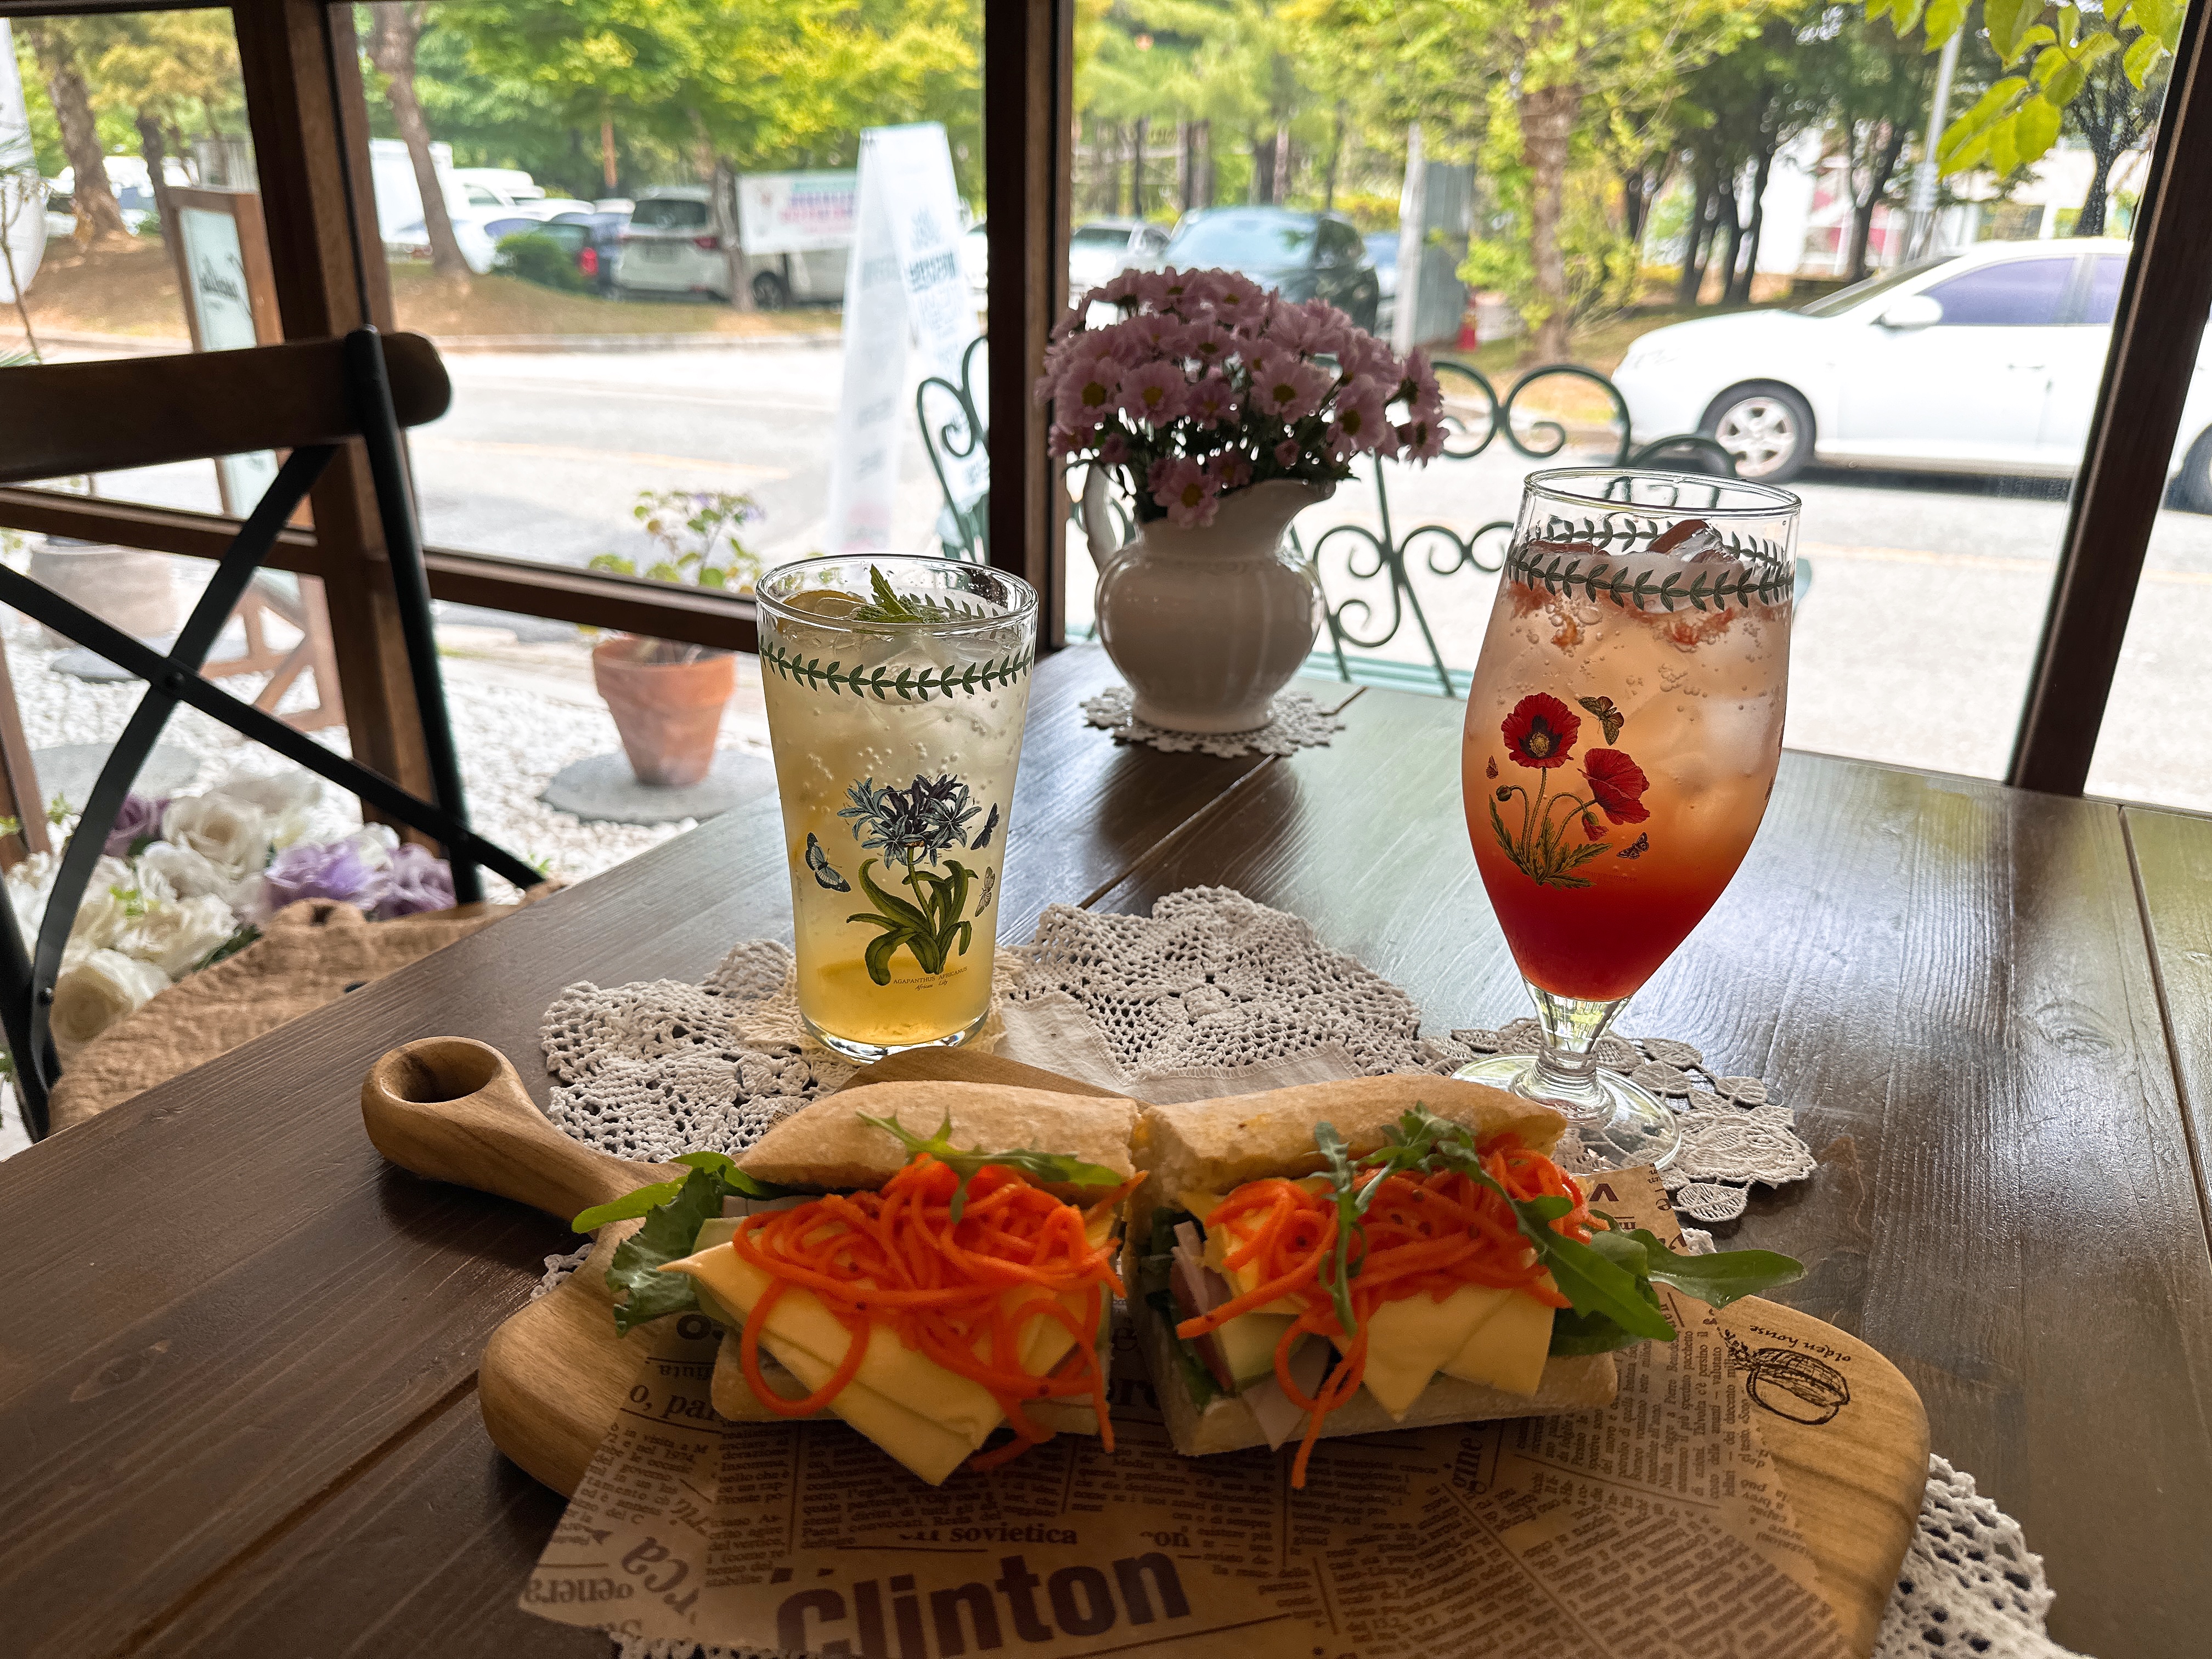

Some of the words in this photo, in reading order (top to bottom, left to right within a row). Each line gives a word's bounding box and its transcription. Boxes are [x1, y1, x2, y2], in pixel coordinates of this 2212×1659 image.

[893, 976, 935, 985] AGAPANTHUS
[938, 967, 967, 980] AFRICANUS
[1683, 1330, 1694, 1371] pacchetto
[1749, 1325, 1798, 1348] house
[1803, 1342, 1851, 1362] olden
[1697, 1344, 1711, 1378] persino
[1709, 1346, 1722, 1386] valutato
[1664, 1379, 1677, 1405] Pierre
[1681, 1374, 1692, 1410] sperduto
[1695, 1383, 1707, 1396] c'è
[1725, 1384, 1736, 1424] duecento
[1693, 1400, 1706, 1436] Talvolta
[950, 1522, 1077, 1544] sovietica
[776, 1552, 1191, 1659] Clinton
